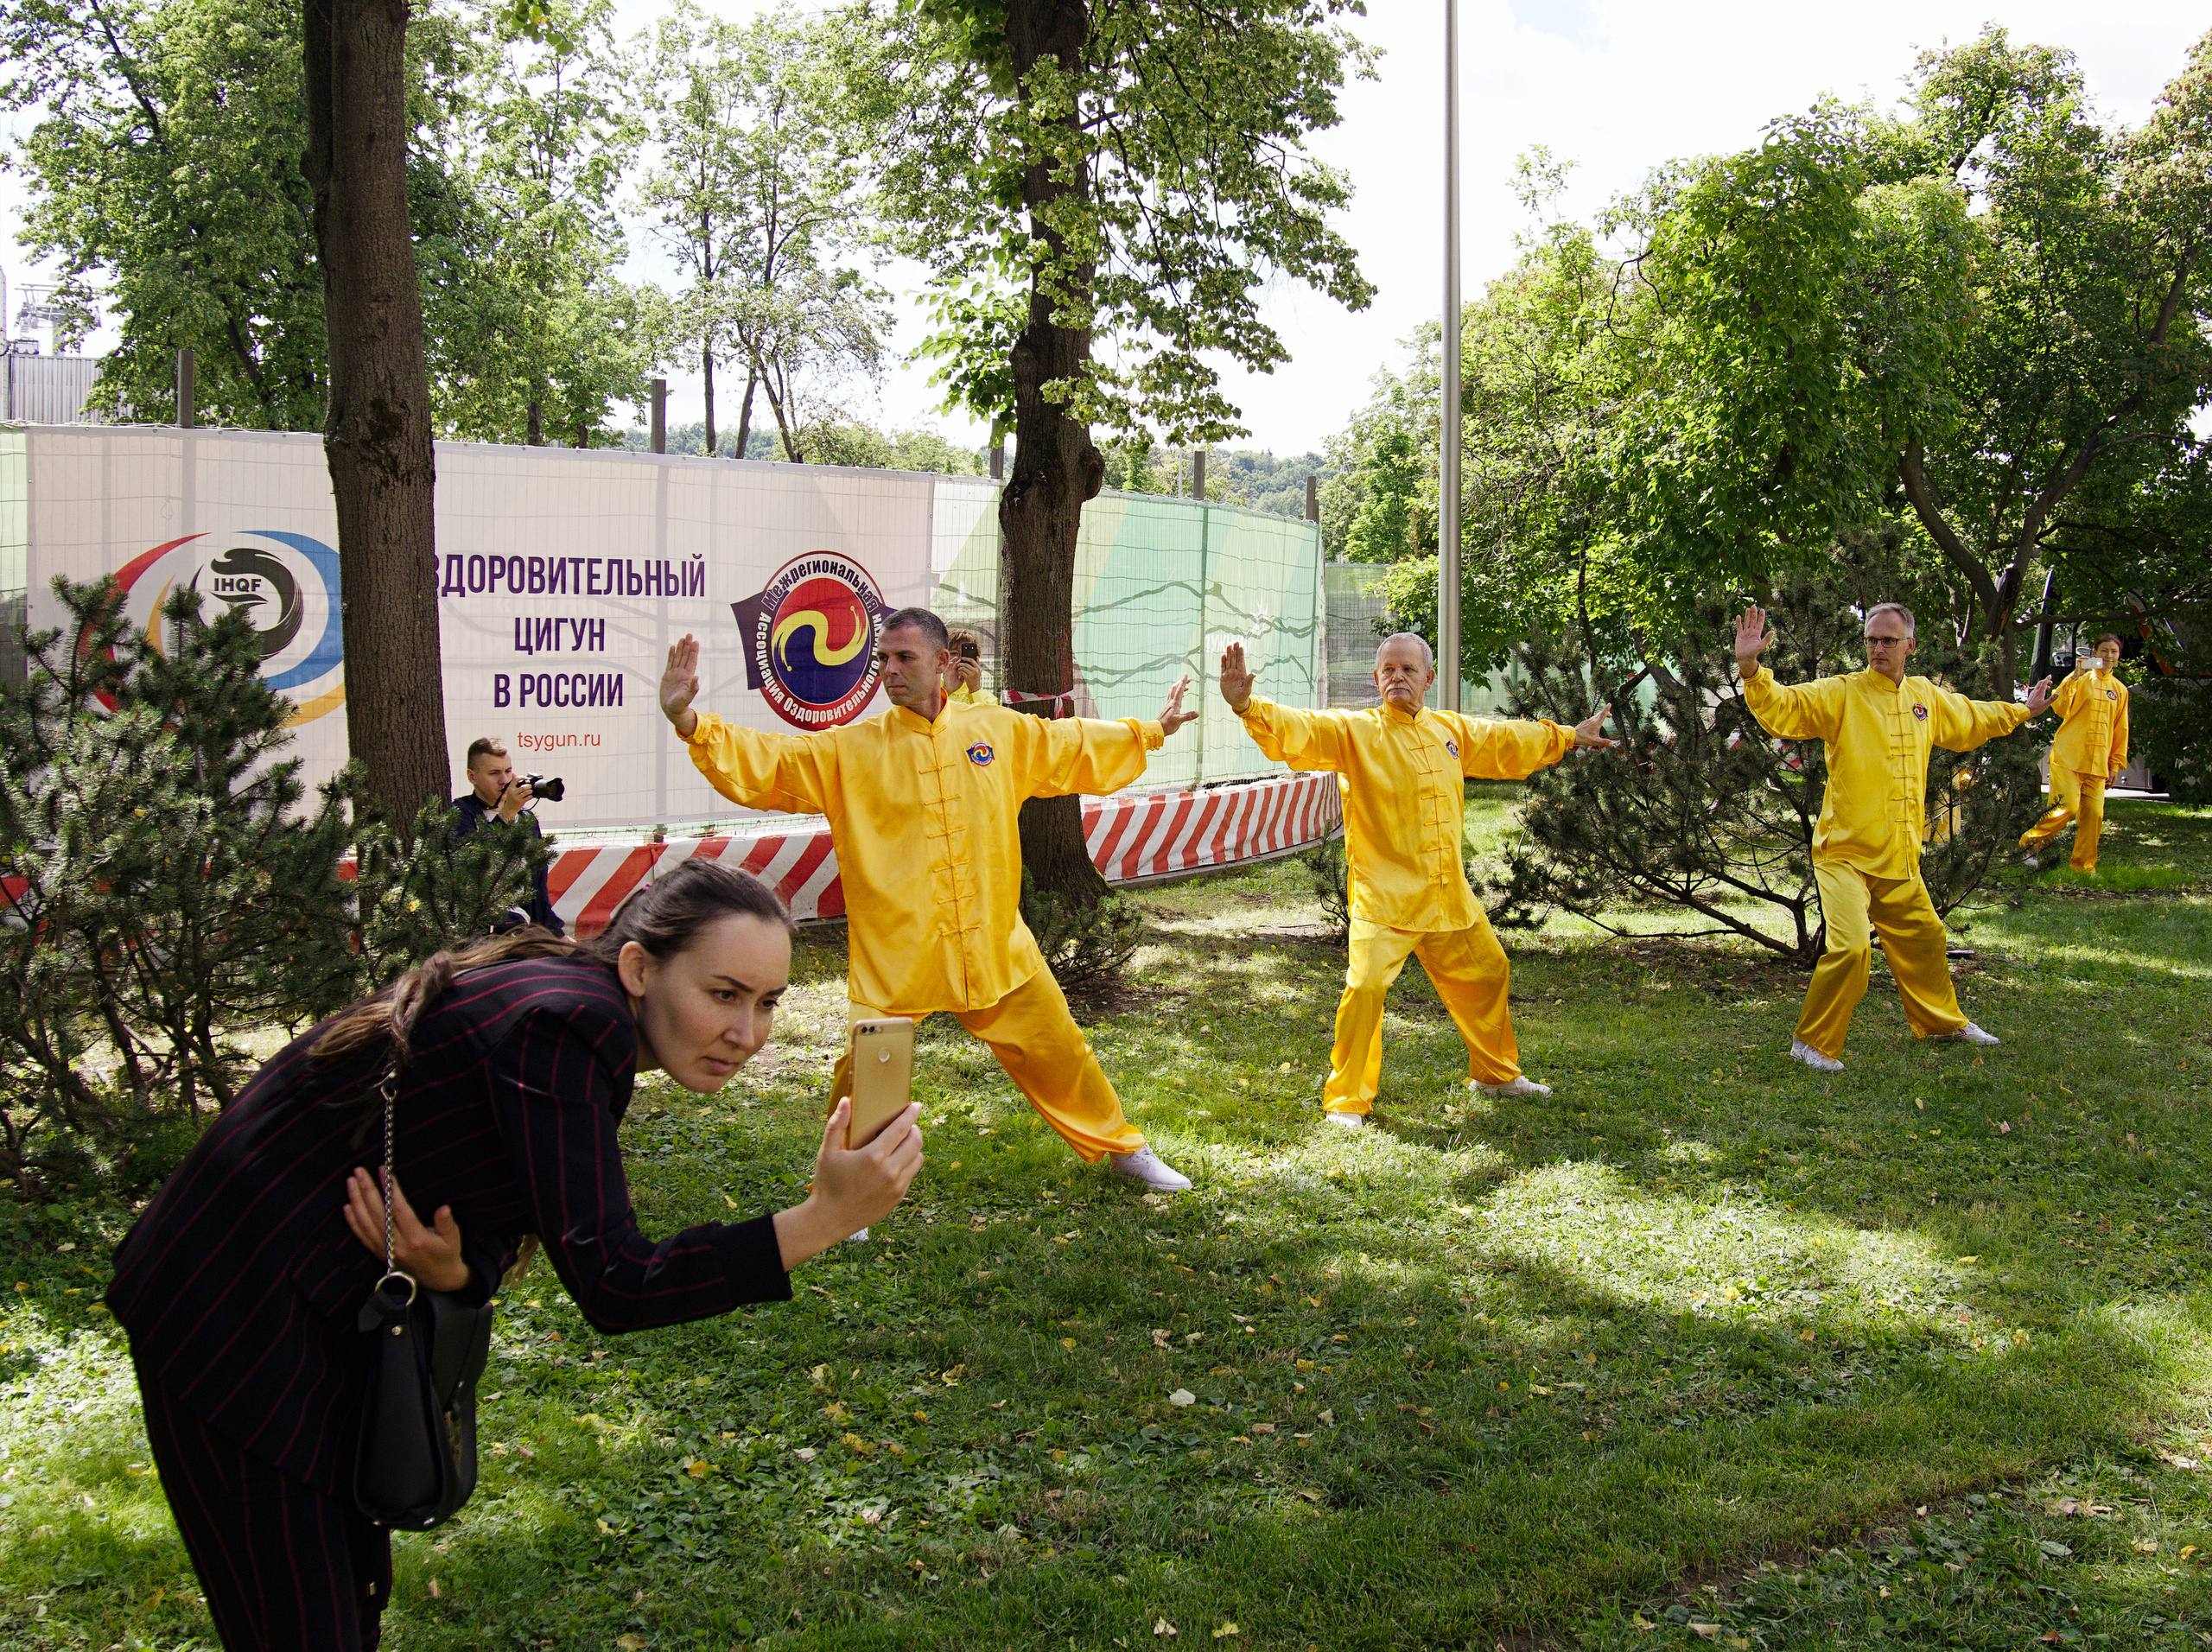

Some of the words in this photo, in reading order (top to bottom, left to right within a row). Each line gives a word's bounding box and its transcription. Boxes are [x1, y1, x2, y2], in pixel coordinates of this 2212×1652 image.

[213, 578, 262, 593] IHQF
[435, 553, 705, 597] ДОРОВИТЕЛЬНЫЙ
[761, 560, 879, 613] Межрегиональная
[514, 617, 605, 655] ЦИГУН
[755, 612, 785, 704] Ассоциация
[783, 659, 880, 724] Оздоровительного
[493, 673, 511, 708] В
[519, 673, 623, 708] РОССИИ
[517, 732, 601, 752] tsygun.ru
